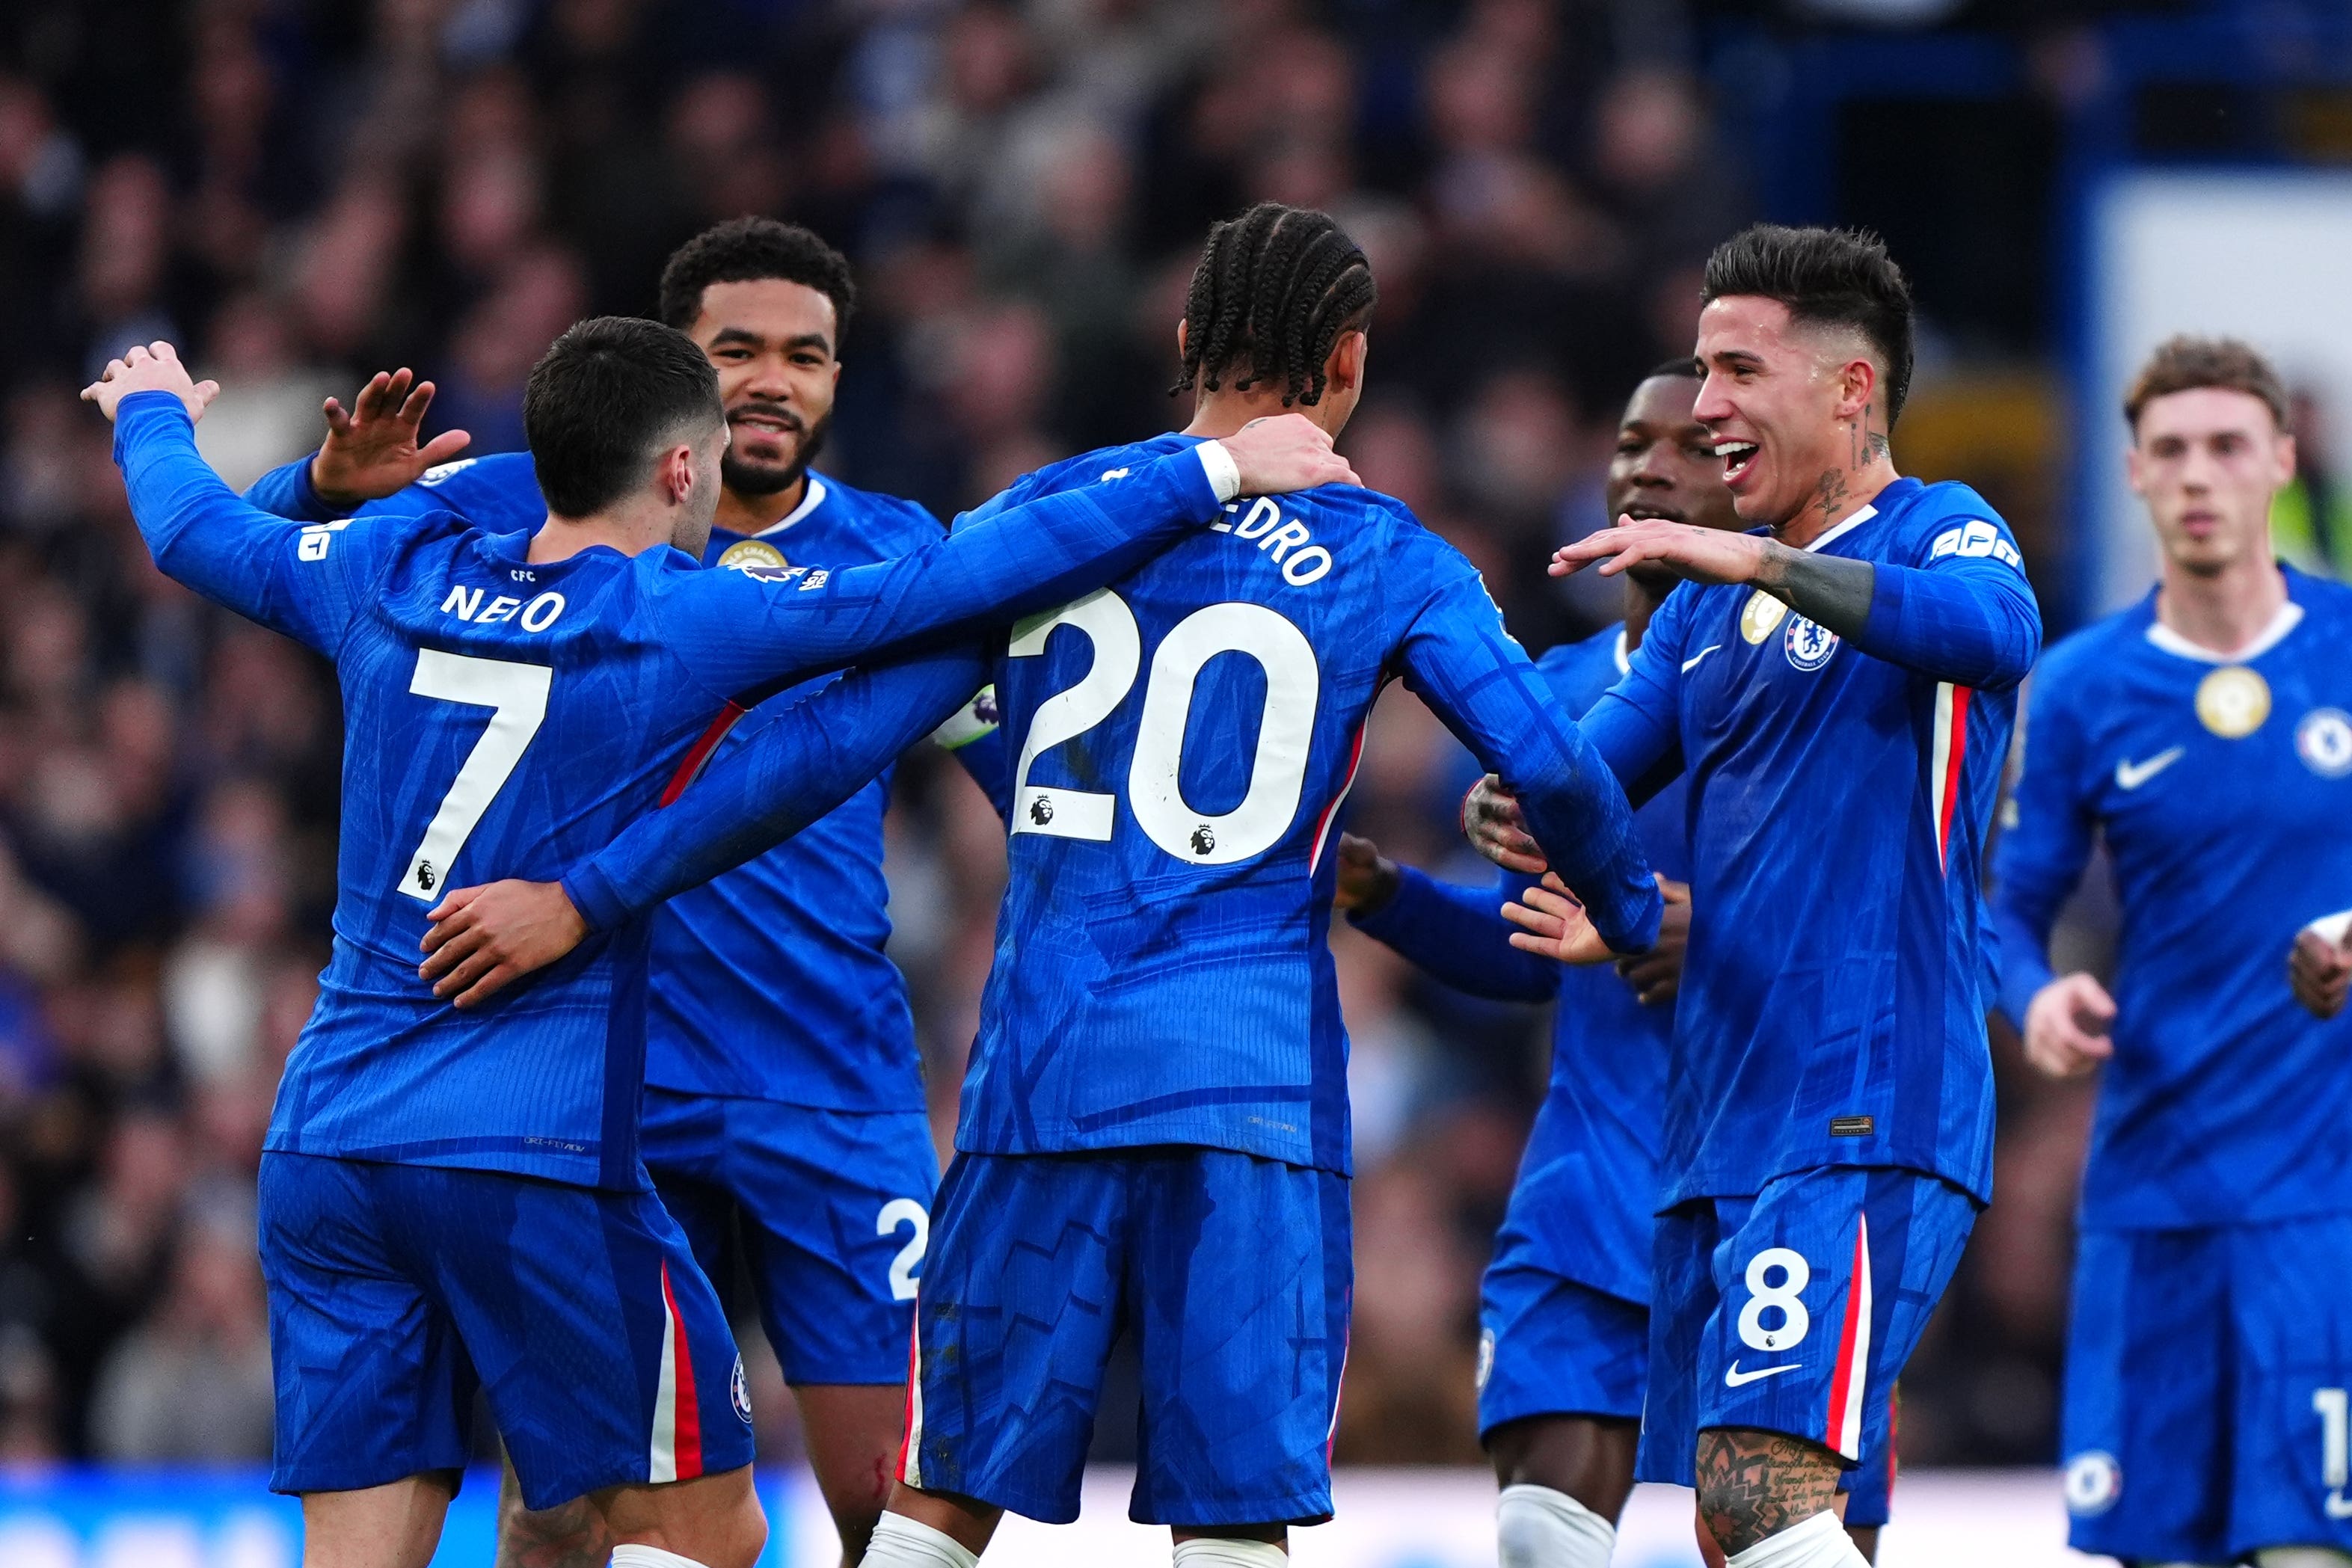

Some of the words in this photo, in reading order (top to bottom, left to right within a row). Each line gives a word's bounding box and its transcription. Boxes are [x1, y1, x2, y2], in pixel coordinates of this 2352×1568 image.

[510, 569, 536, 582] CFC
[1209, 496, 1333, 586] EDRO
[396, 648, 553, 903] 7
[1007, 588, 1320, 866] 20
[1737, 1247, 1810, 1351] 8
[2313, 1388, 2352, 1486] 1
